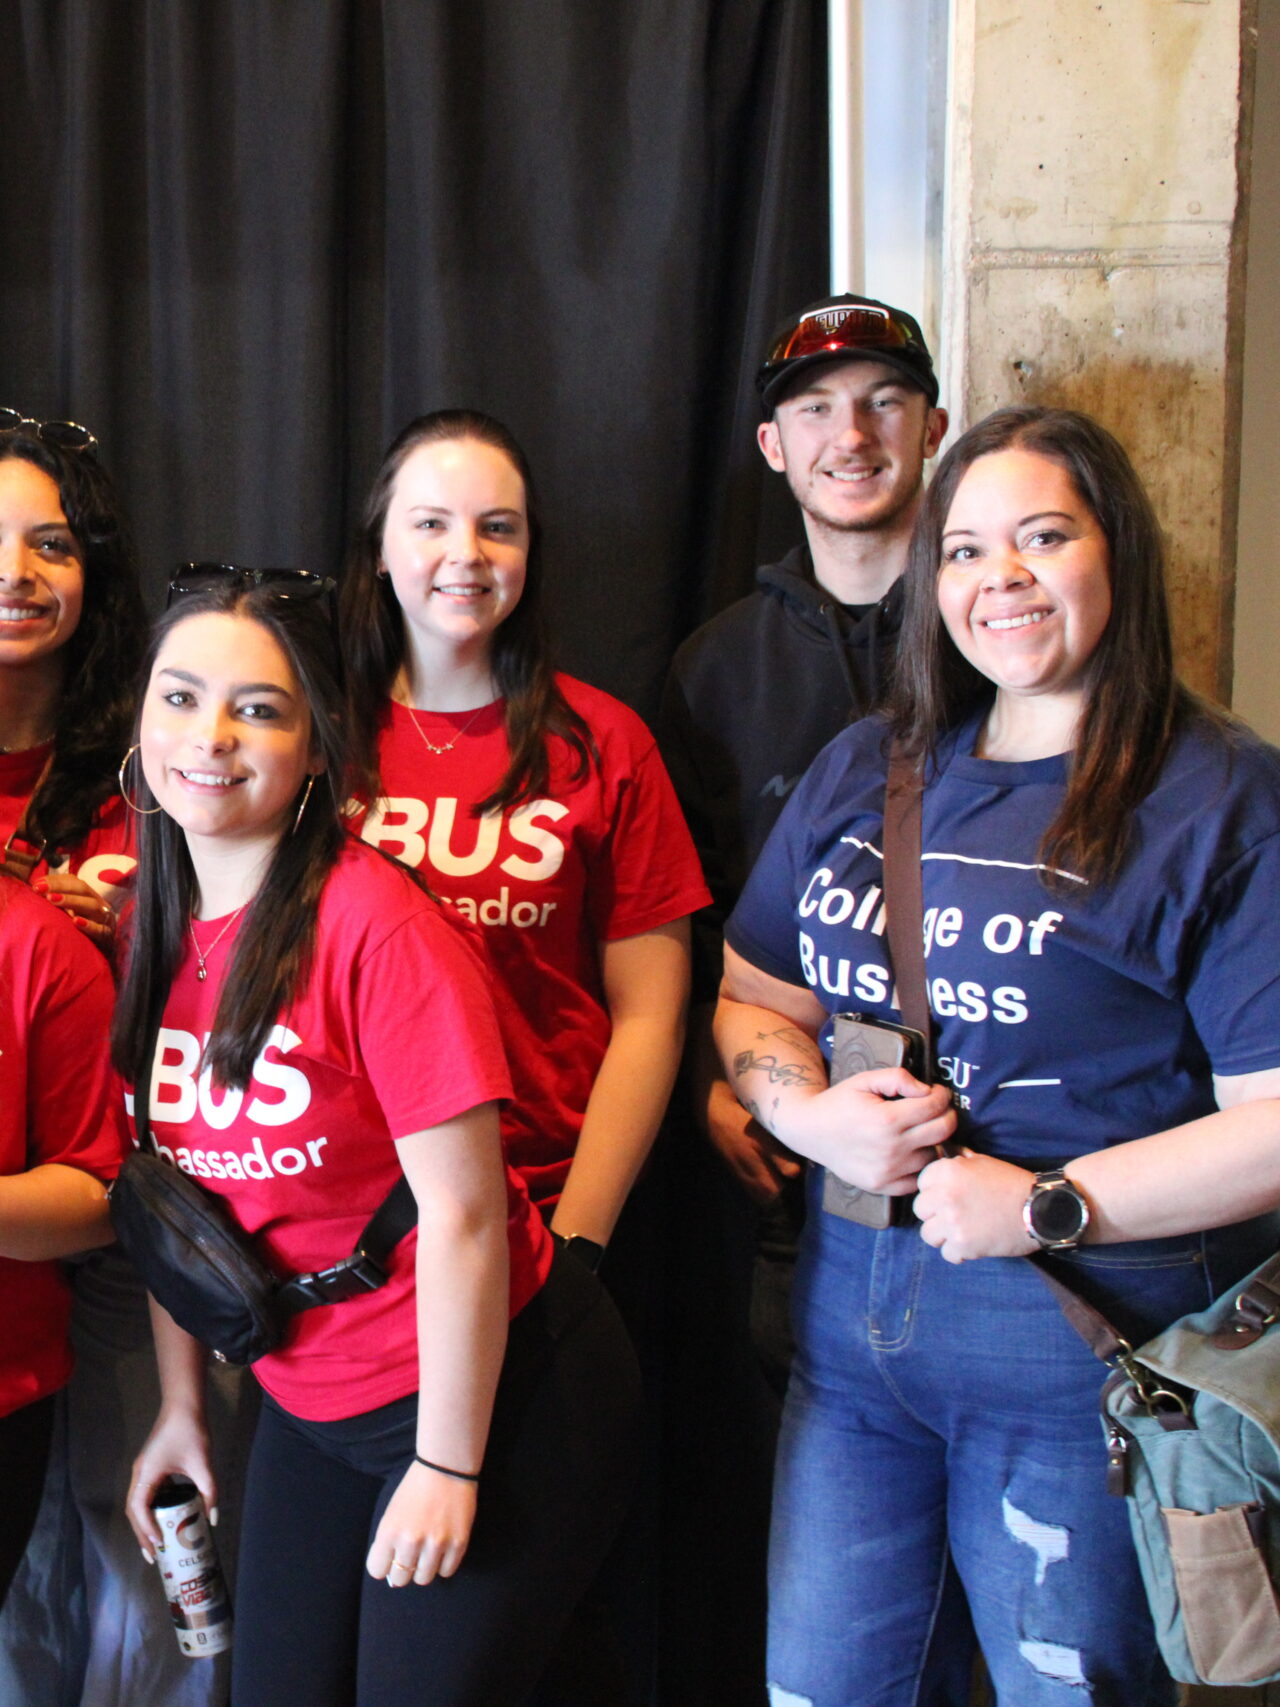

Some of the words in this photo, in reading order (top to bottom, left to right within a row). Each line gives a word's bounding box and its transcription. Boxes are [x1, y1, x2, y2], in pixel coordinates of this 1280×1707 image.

[340, 797, 570, 881] BUS
[982, 911, 1063, 955] of
[799, 931, 1028, 1024] Busess
[124, 1024, 312, 1131] BUS
[938, 1057, 971, 1089] SU
[132, 1131, 328, 1180] bassador
